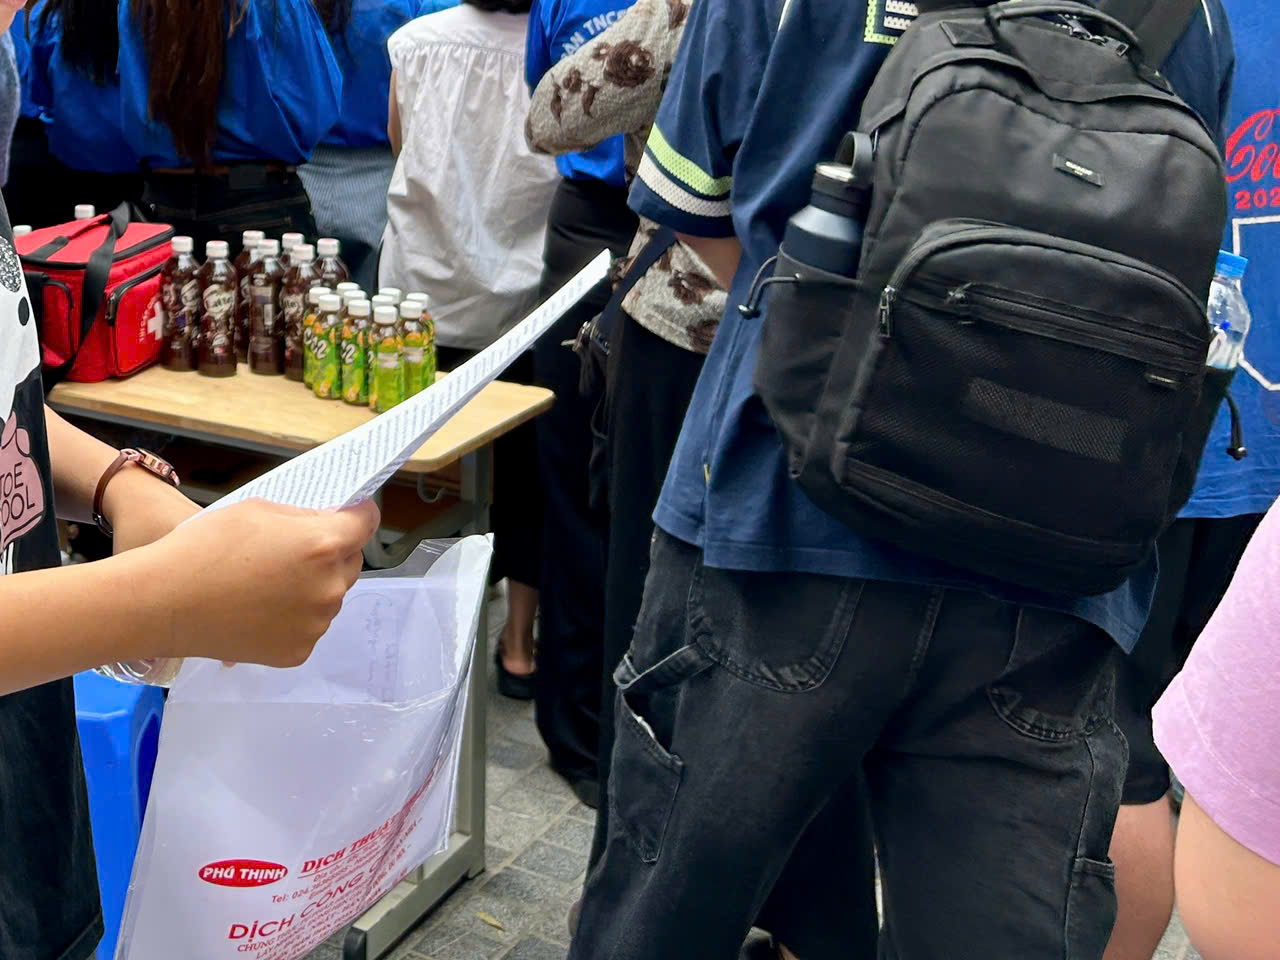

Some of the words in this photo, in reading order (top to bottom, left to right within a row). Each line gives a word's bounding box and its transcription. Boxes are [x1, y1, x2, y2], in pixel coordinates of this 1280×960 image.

[301, 848, 346, 873] DỊCH
[202, 865, 237, 880] PHÚ
[239, 867, 287, 883] THỊNH
[228, 913, 295, 942] DỊCH
